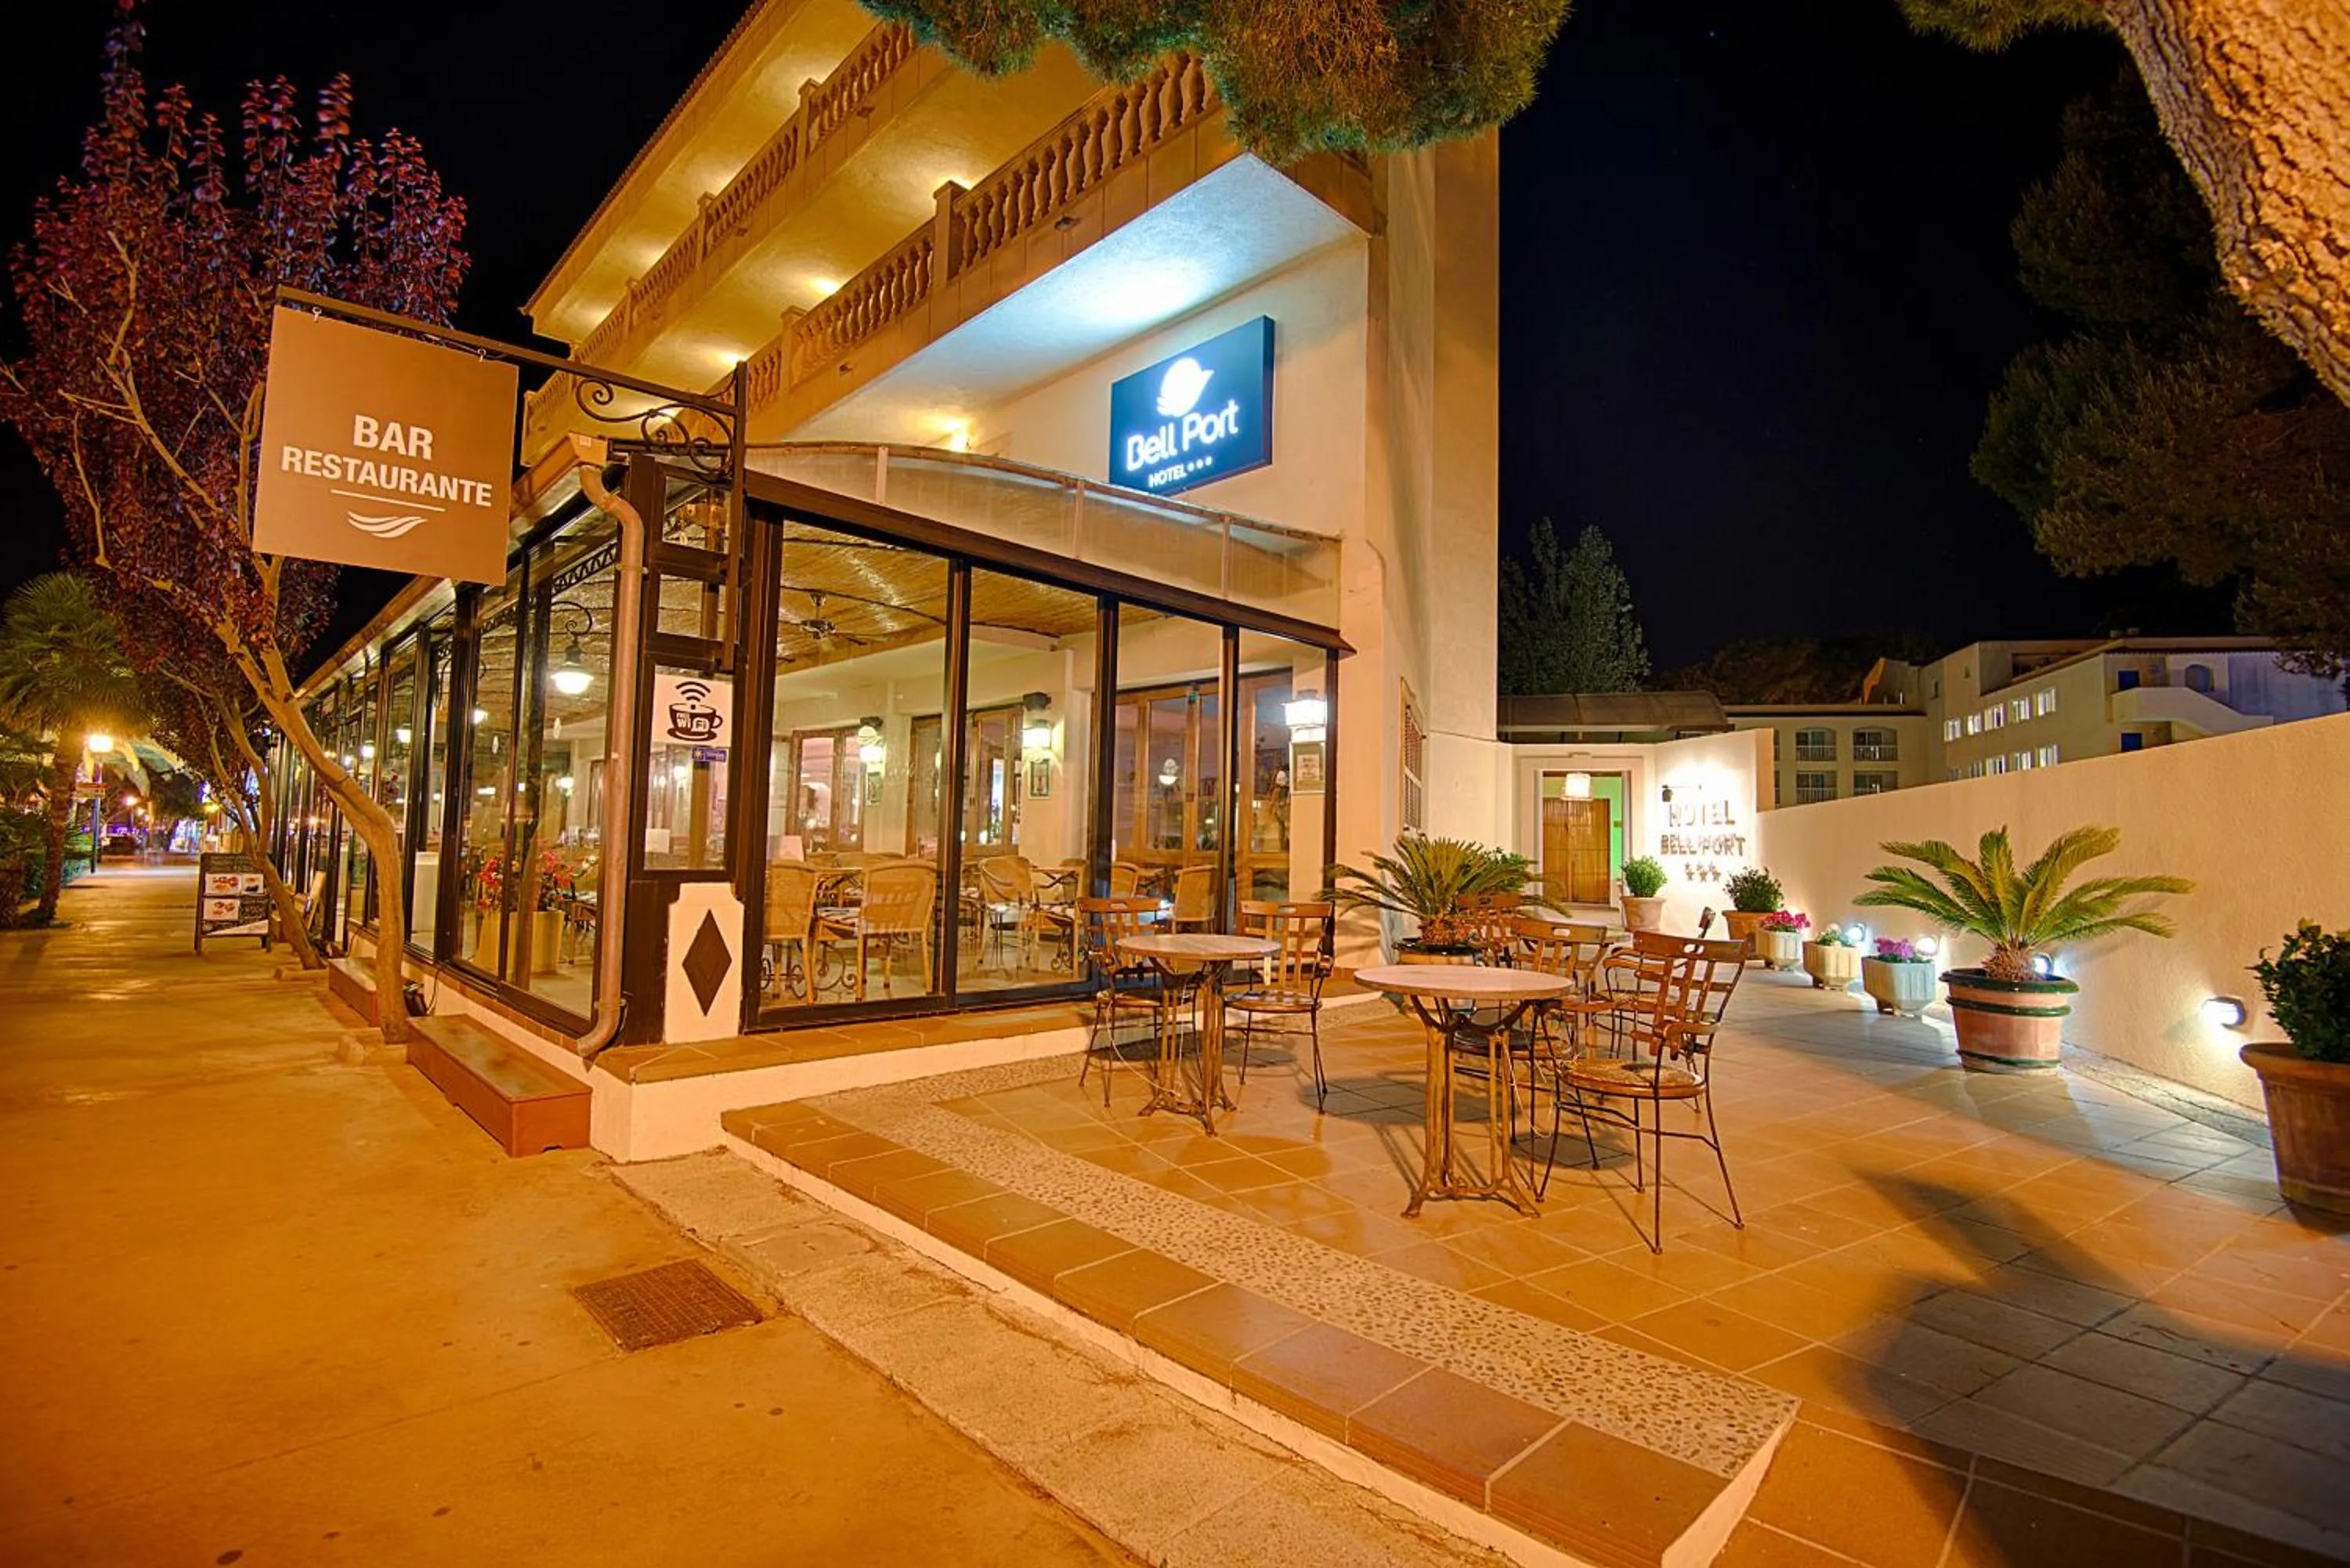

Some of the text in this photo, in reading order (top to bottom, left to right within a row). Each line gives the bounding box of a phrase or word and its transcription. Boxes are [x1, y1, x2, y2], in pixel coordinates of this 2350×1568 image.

[352, 414, 434, 461] BAR
[1127, 399, 1240, 471] Bell Port
[281, 446, 494, 508] RESTAURANTE
[1148, 464, 1188, 488] HOTEL
[1660, 834, 1746, 856] BELL PORT
